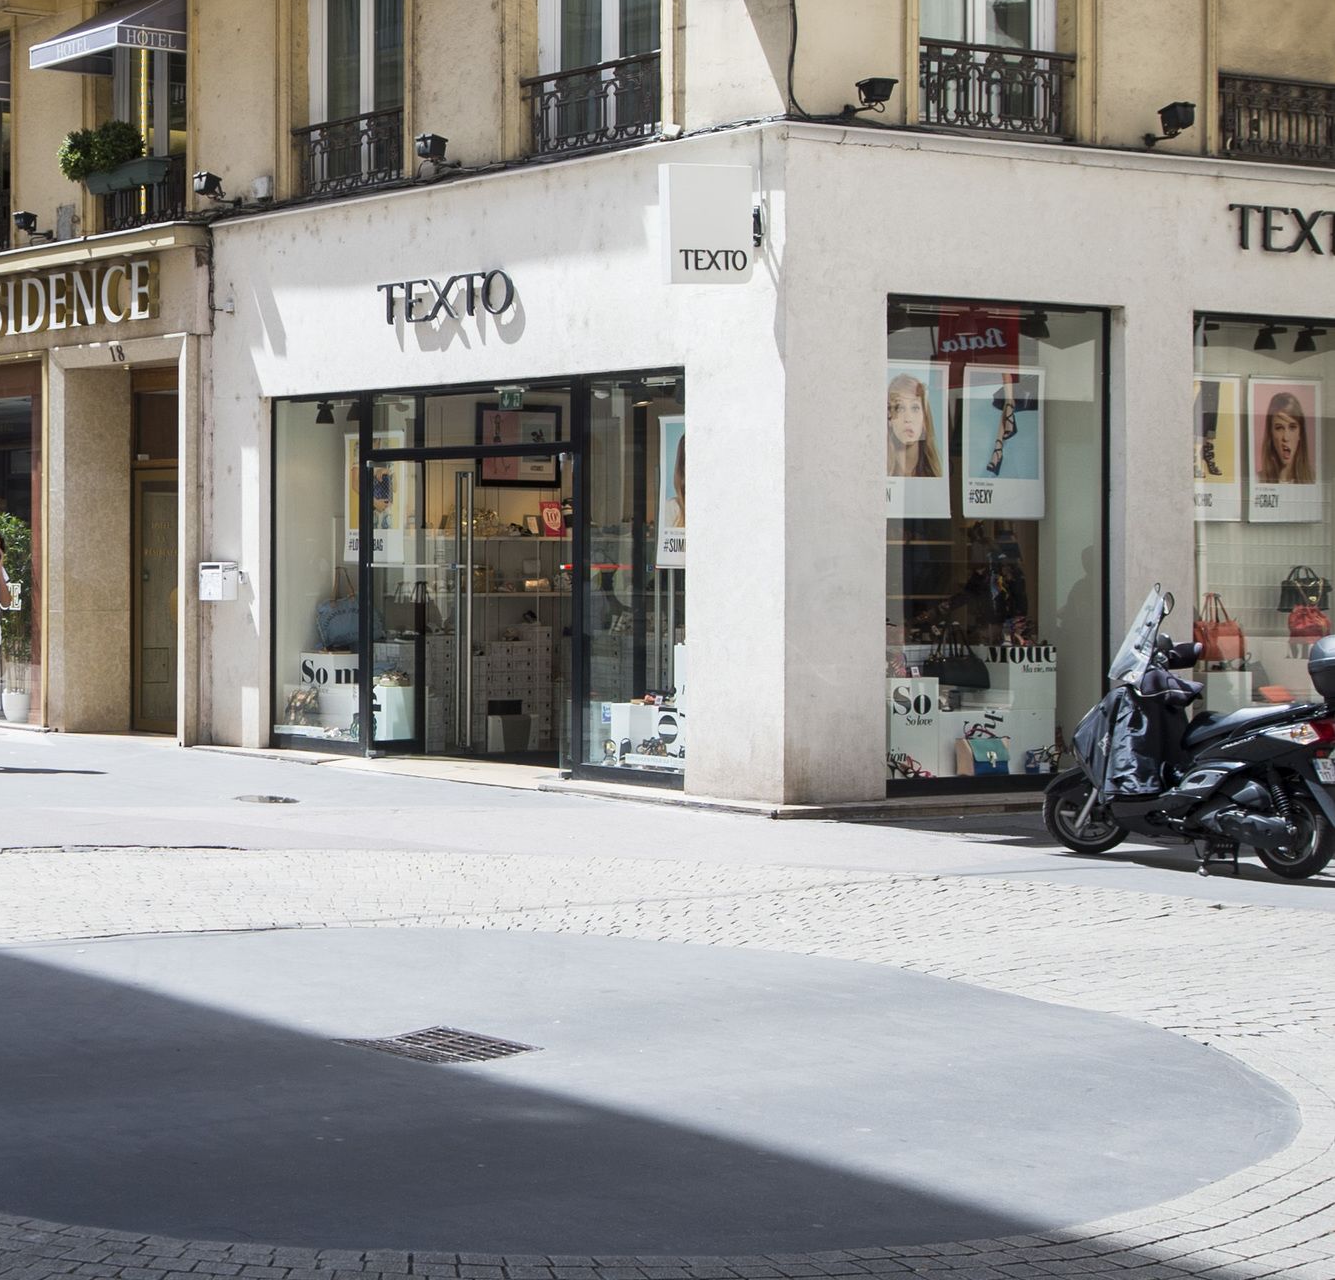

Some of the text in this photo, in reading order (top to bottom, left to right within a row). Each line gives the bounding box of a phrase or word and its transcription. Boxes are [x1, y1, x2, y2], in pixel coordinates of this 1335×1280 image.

[56, 37, 90, 59] HOTEL
[125, 28, 177, 49] HOTEL
[679, 248, 748, 272] TEXTO
[376, 268, 515, 325] TEXTO
[110, 342, 126, 363] 18
[968, 488, 994, 504] #SEXY
[1254, 493, 1280, 509] #CRAZY
[301, 658, 329, 685] So
[892, 686, 932, 715] So
[905, 715, 933, 726] So love
